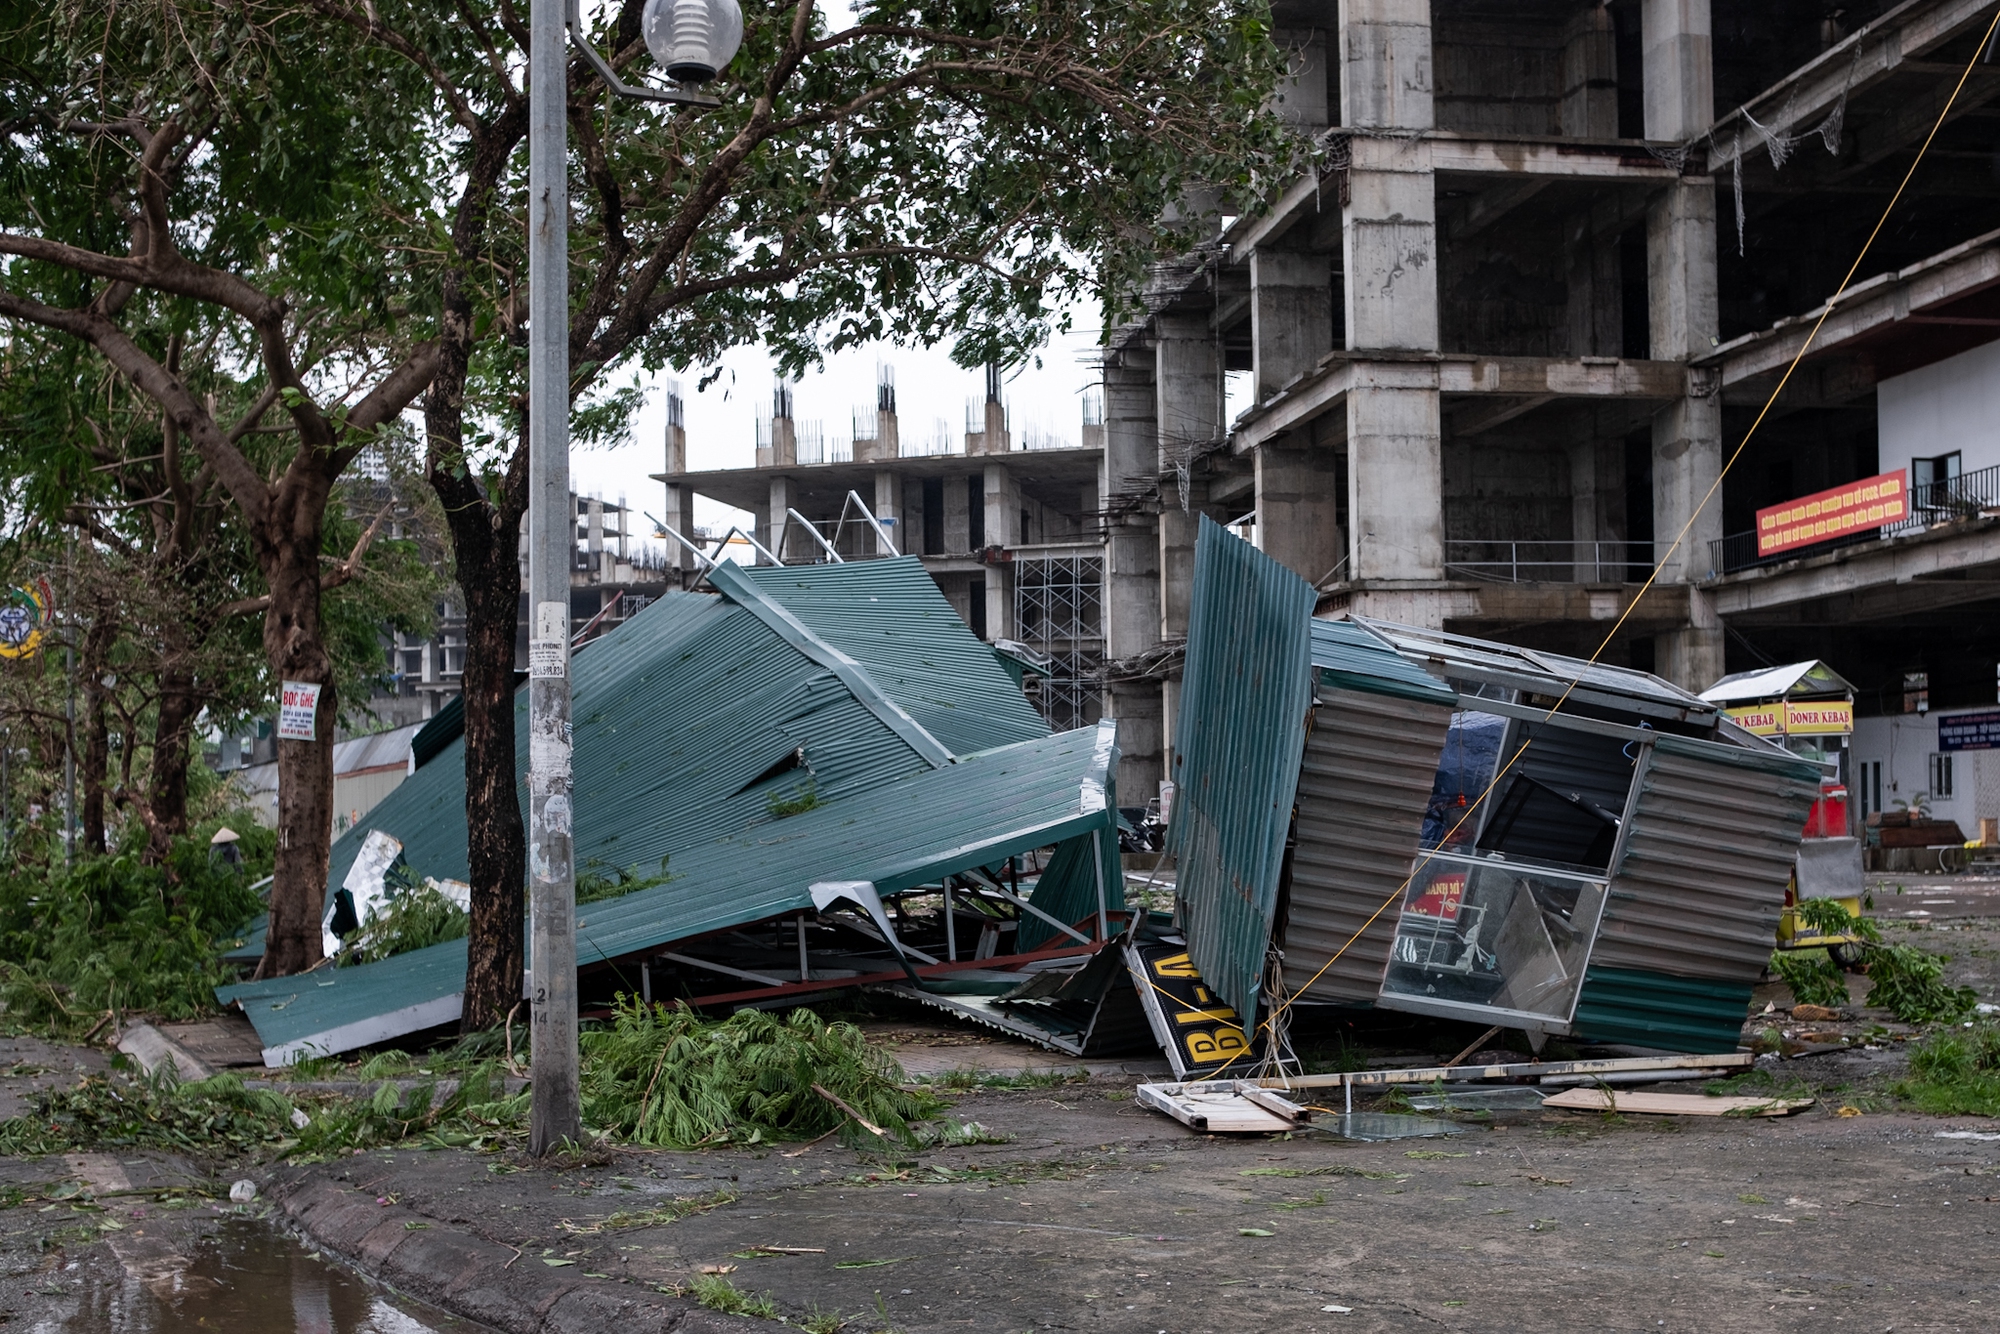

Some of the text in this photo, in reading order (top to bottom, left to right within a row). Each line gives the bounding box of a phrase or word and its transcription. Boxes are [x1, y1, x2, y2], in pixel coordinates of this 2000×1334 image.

[283, 691, 315, 709] BỌC GHẾ
[1744, 713, 1775, 728] KEBAB
[1790, 711, 1850, 724] DONER KEBAB
